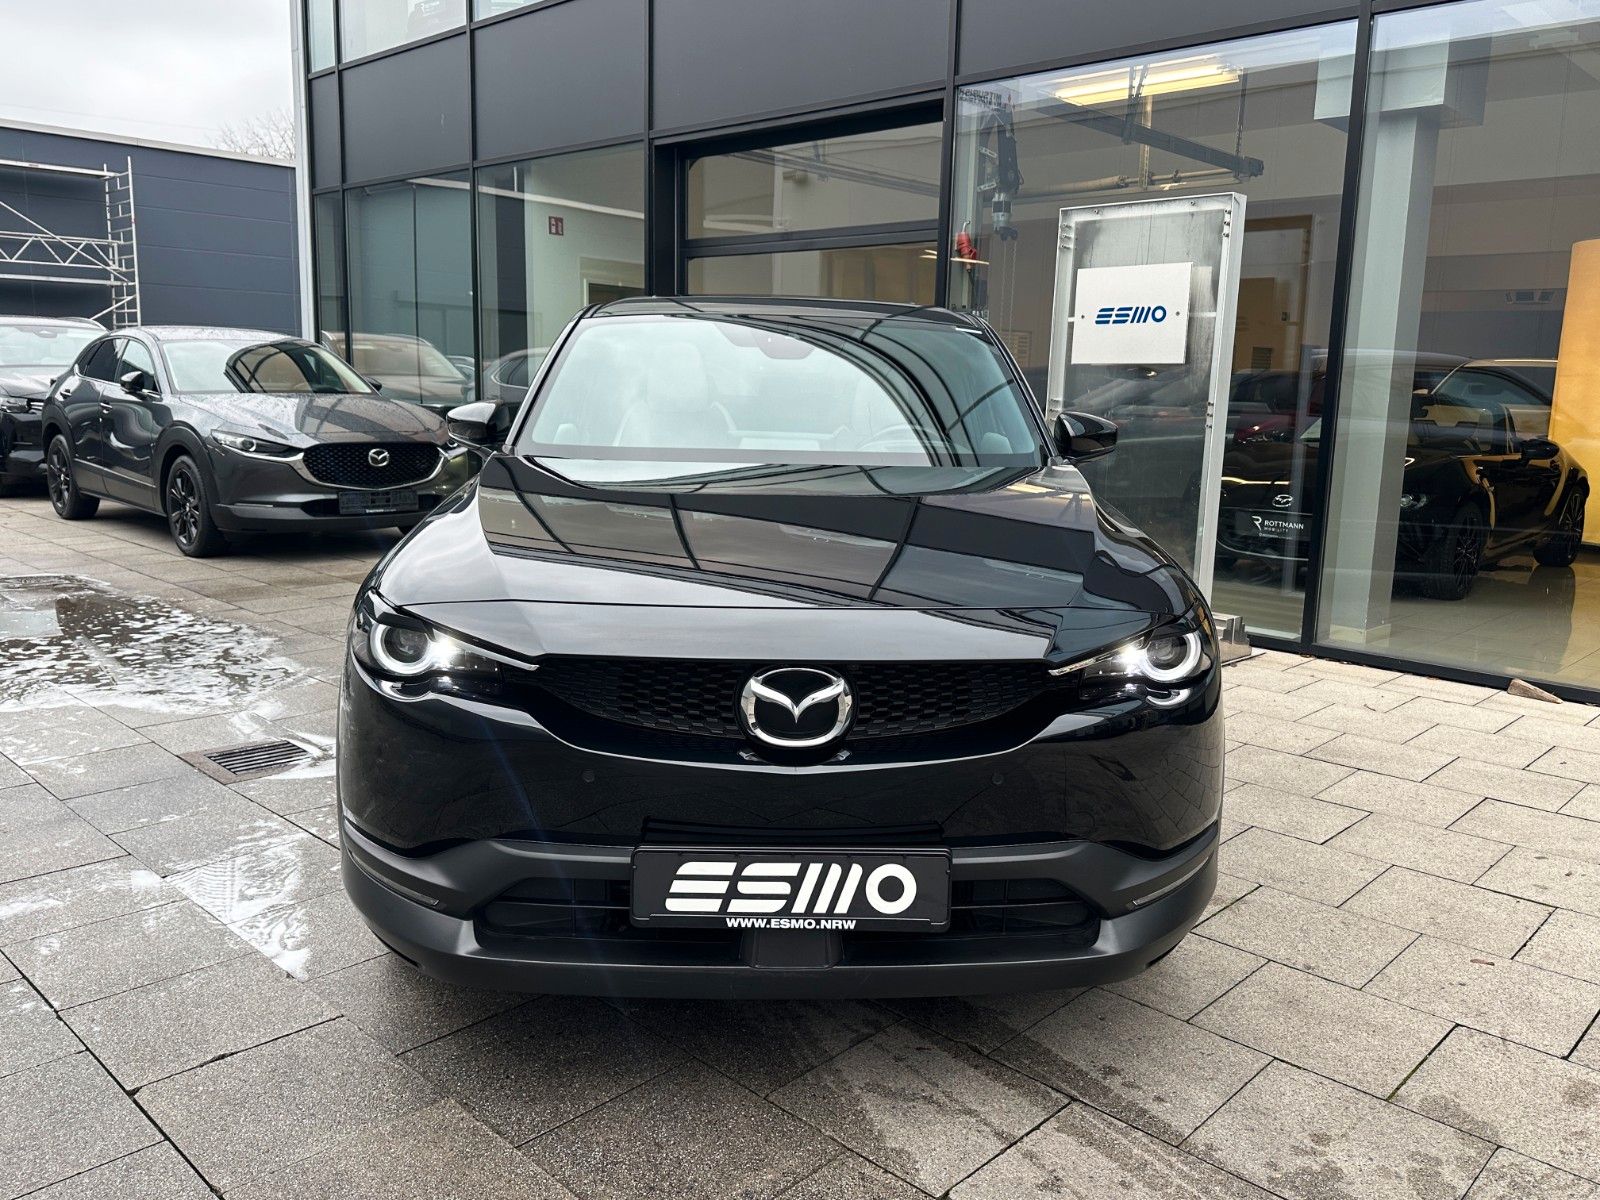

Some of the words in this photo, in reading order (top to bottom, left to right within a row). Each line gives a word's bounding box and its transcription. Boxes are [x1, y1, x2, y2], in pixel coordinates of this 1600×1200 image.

[1094, 305, 1167, 325] ESMO
[1264, 520, 1304, 530] ROTTMANN
[665, 861, 917, 915] ESMO
[725, 917, 857, 930] WWW.ESMO.NRW
